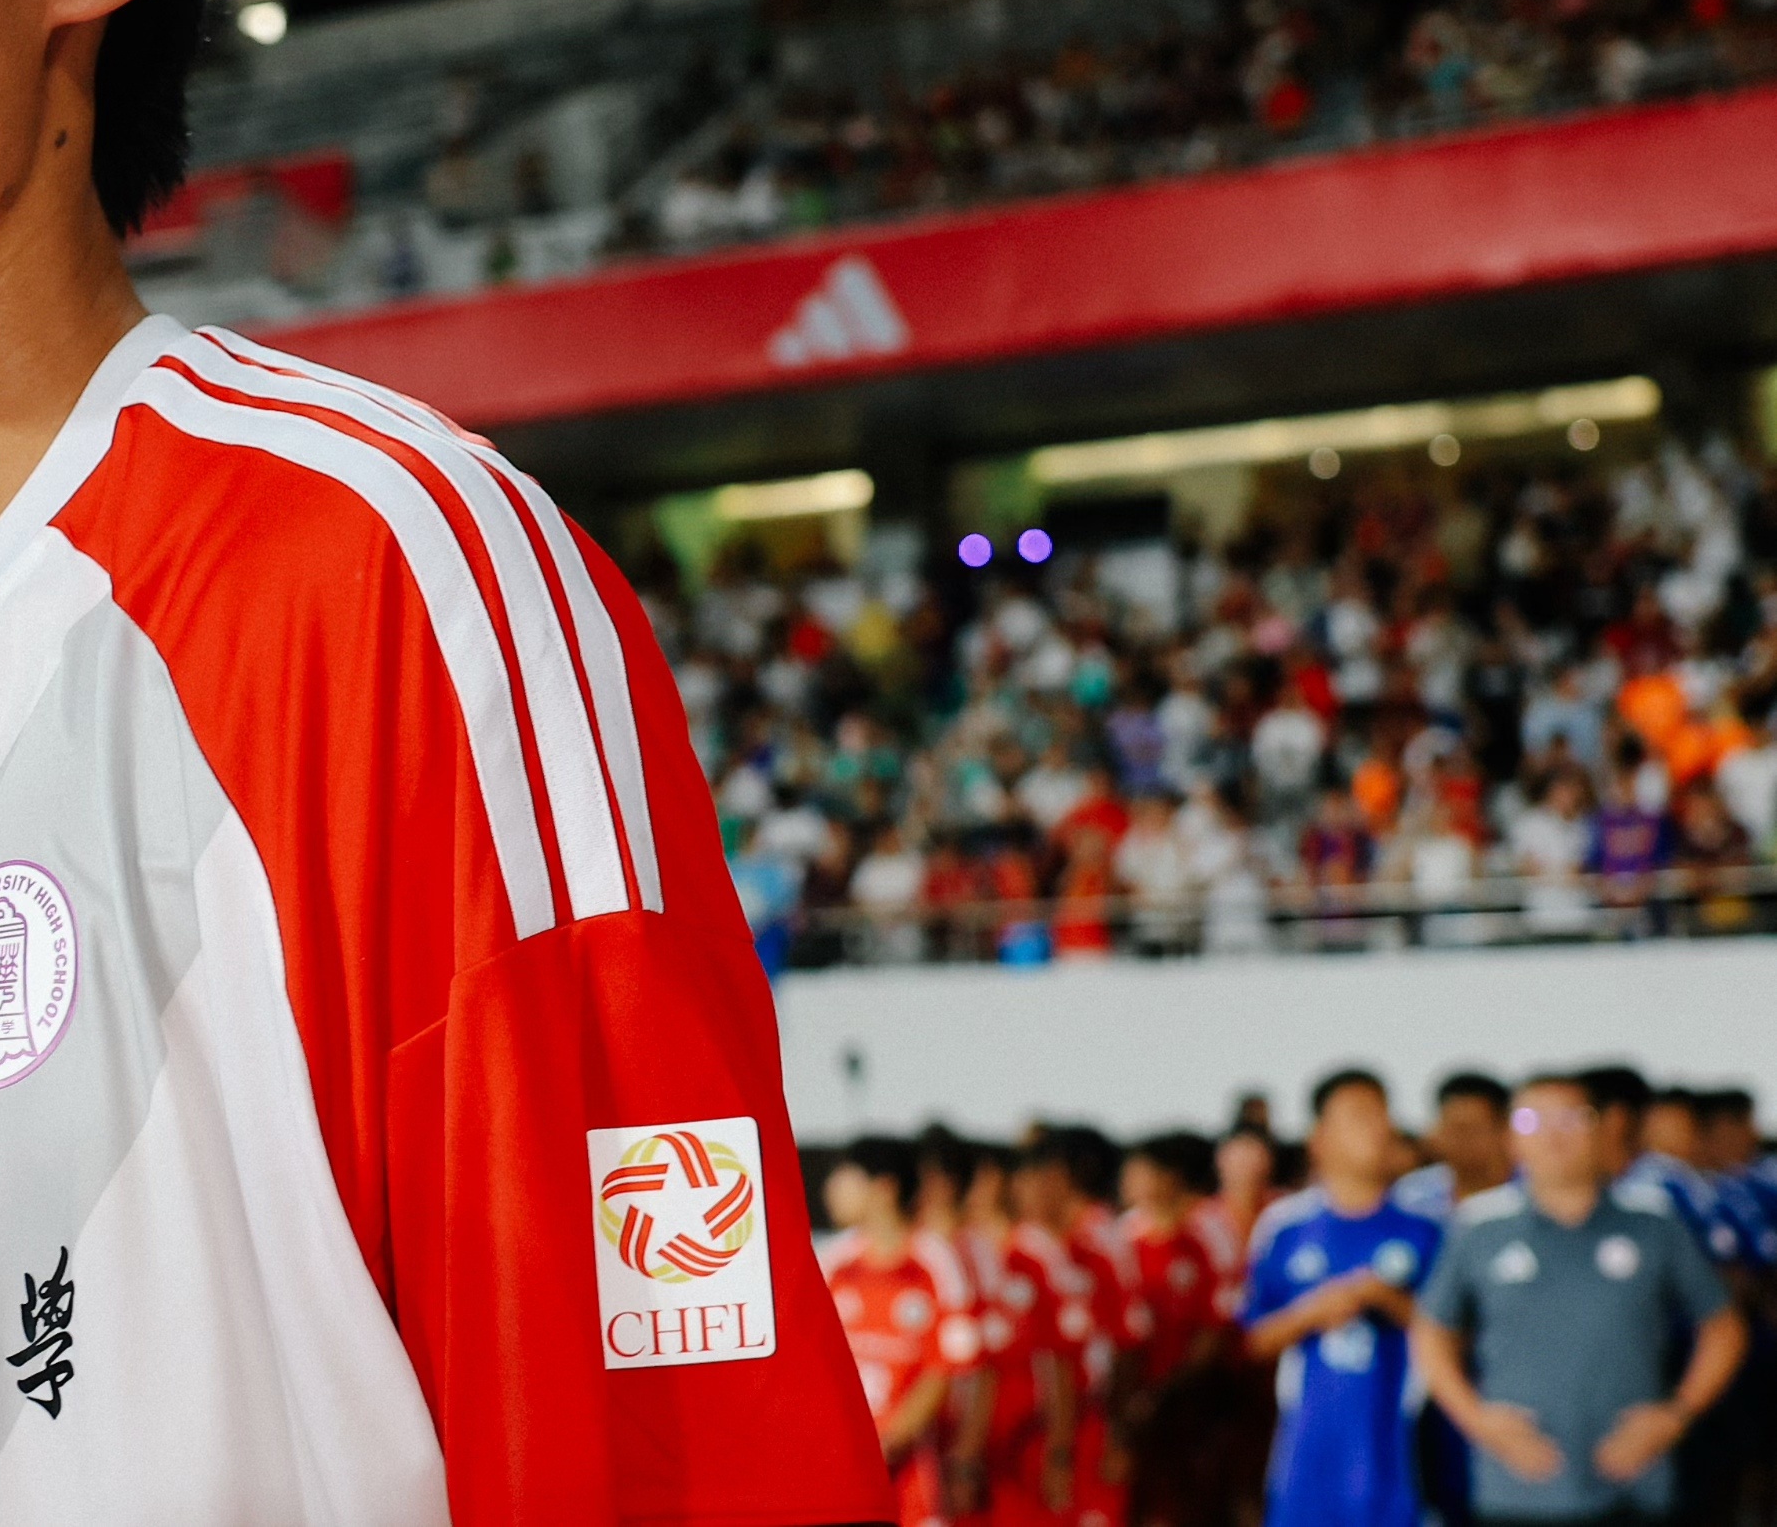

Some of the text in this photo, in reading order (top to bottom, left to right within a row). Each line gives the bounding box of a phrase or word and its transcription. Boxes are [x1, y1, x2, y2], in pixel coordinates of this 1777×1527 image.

[34, 887, 64, 934] HIGH
[36, 937, 67, 1029] SCHOOL
[606, 1302, 767, 1358] CHFL
